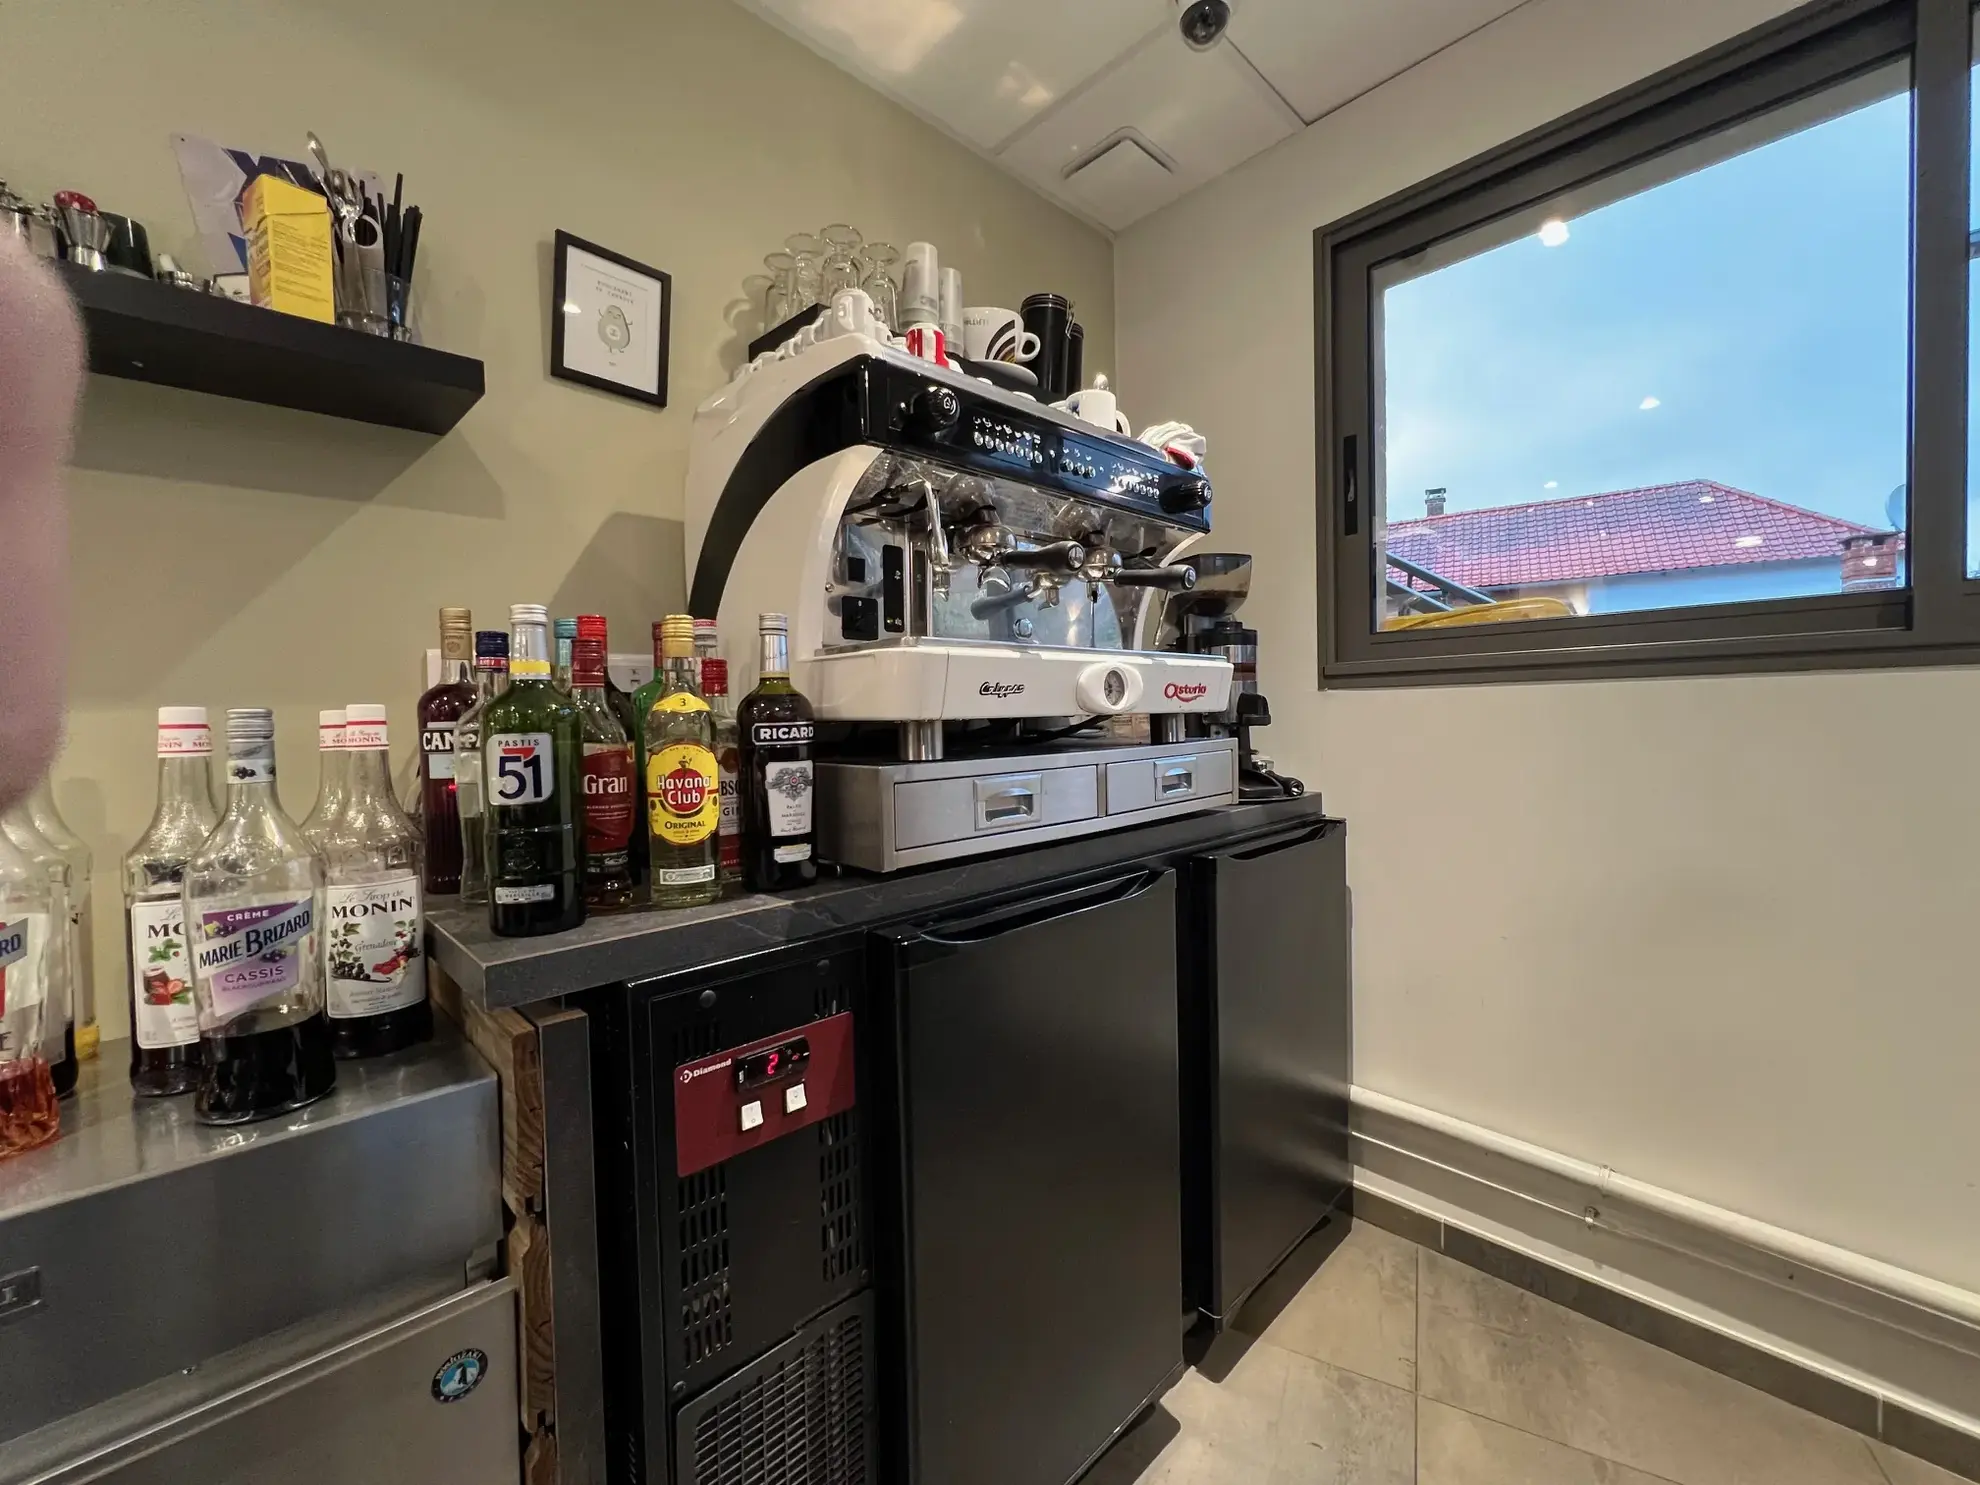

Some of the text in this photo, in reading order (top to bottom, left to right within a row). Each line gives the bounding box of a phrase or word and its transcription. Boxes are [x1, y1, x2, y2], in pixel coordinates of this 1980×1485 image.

[1164, 682, 1207, 702] Astoria
[680, 698, 686, 706] 3
[422, 732, 480, 750] CAMP
[760, 726, 814, 740] RICARD
[498, 738, 540, 747] PASTIS
[498, 754, 543, 799] 51
[657, 775, 711, 790] Havana
[667, 793, 701, 805] Club
[664, 820, 706, 830] ORIGINAL
[226, 909, 270, 922] CRÈME
[332, 896, 414, 919] MONIN
[199, 910, 310, 969] MARIE BRIZARD
[224, 965, 284, 984] CASSIS
[693, 1058, 732, 1077] Diamond
[766, 1053, 779, 1075] 2
